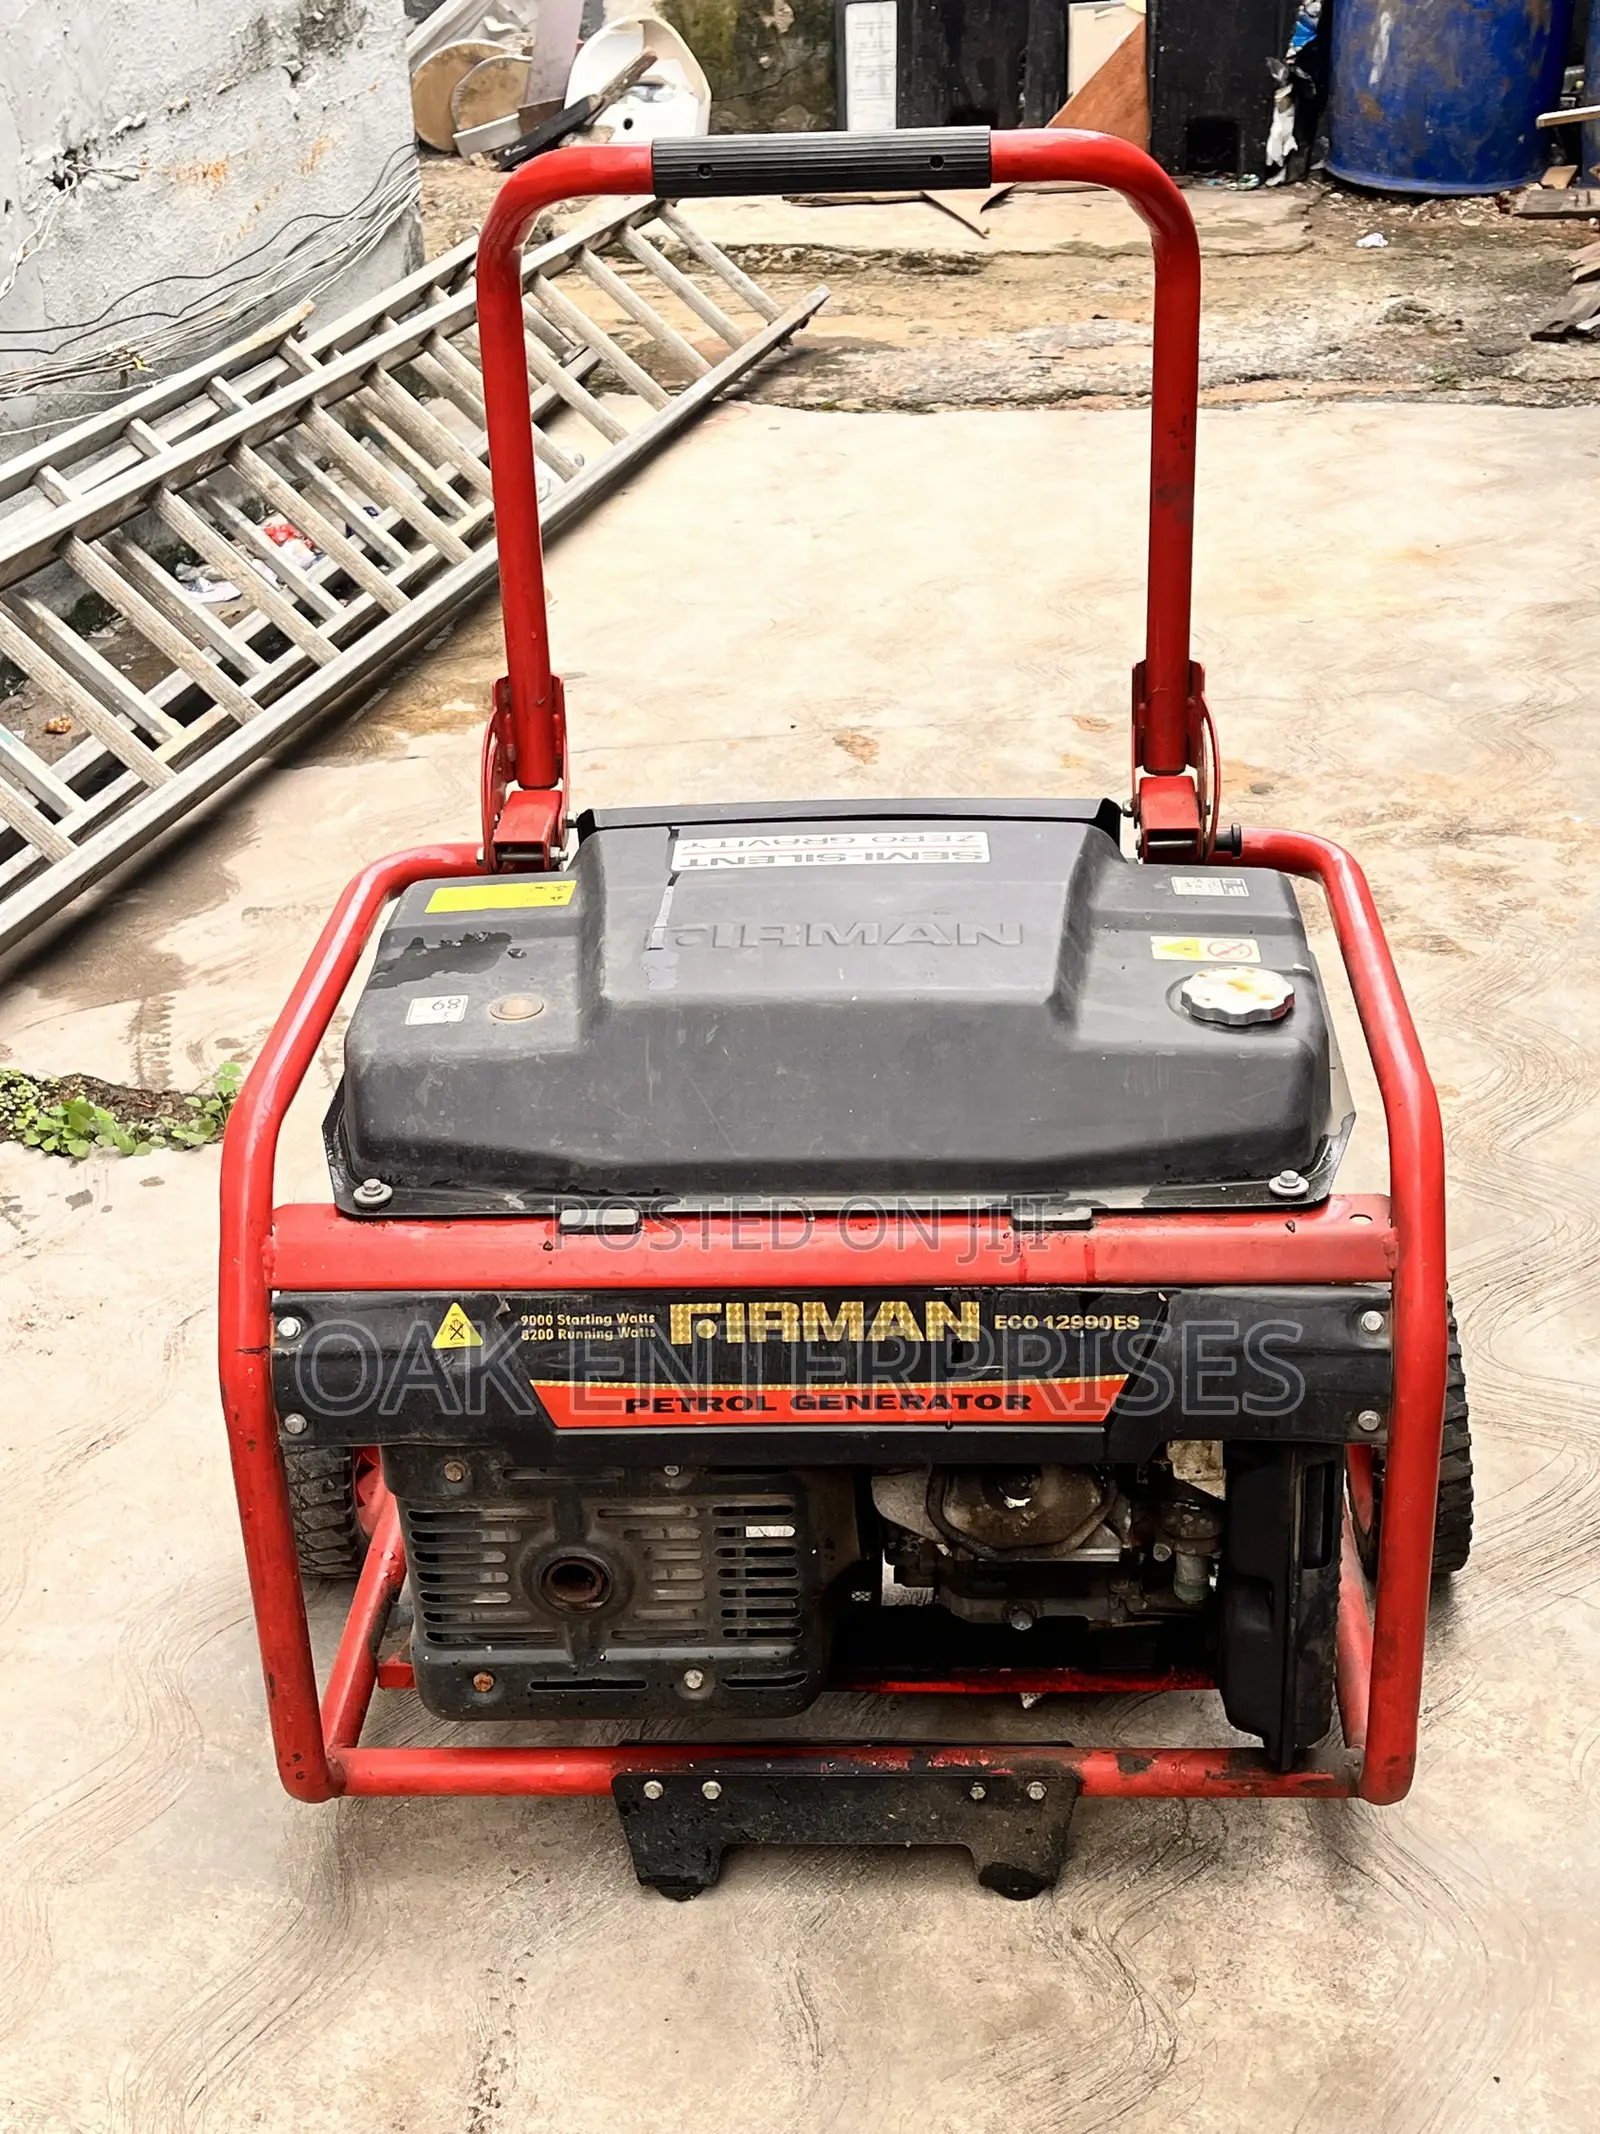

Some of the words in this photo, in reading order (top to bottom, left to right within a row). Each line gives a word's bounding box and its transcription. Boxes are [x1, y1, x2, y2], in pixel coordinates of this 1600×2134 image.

[682, 835, 856, 849] GRAVITY
[871, 834, 979, 845] ZERO
[681, 850, 983, 868] SEMI-SILENT
[520, 1315, 553, 1326] 9000
[557, 1313, 613, 1328] Starting
[616, 1313, 656, 1324] Watts
[669, 1301, 980, 1345] FIRMAN
[994, 1315, 1038, 1330] ECO
[1042, 1315, 1140, 1331] 12990ES
[520, 1329, 554, 1341] 8200
[558, 1327, 613, 1343] Running
[616, 1327, 657, 1339] Watts
[625, 1394, 776, 1414] PETROL
[790, 1394, 1032, 1412] GENERATOR
